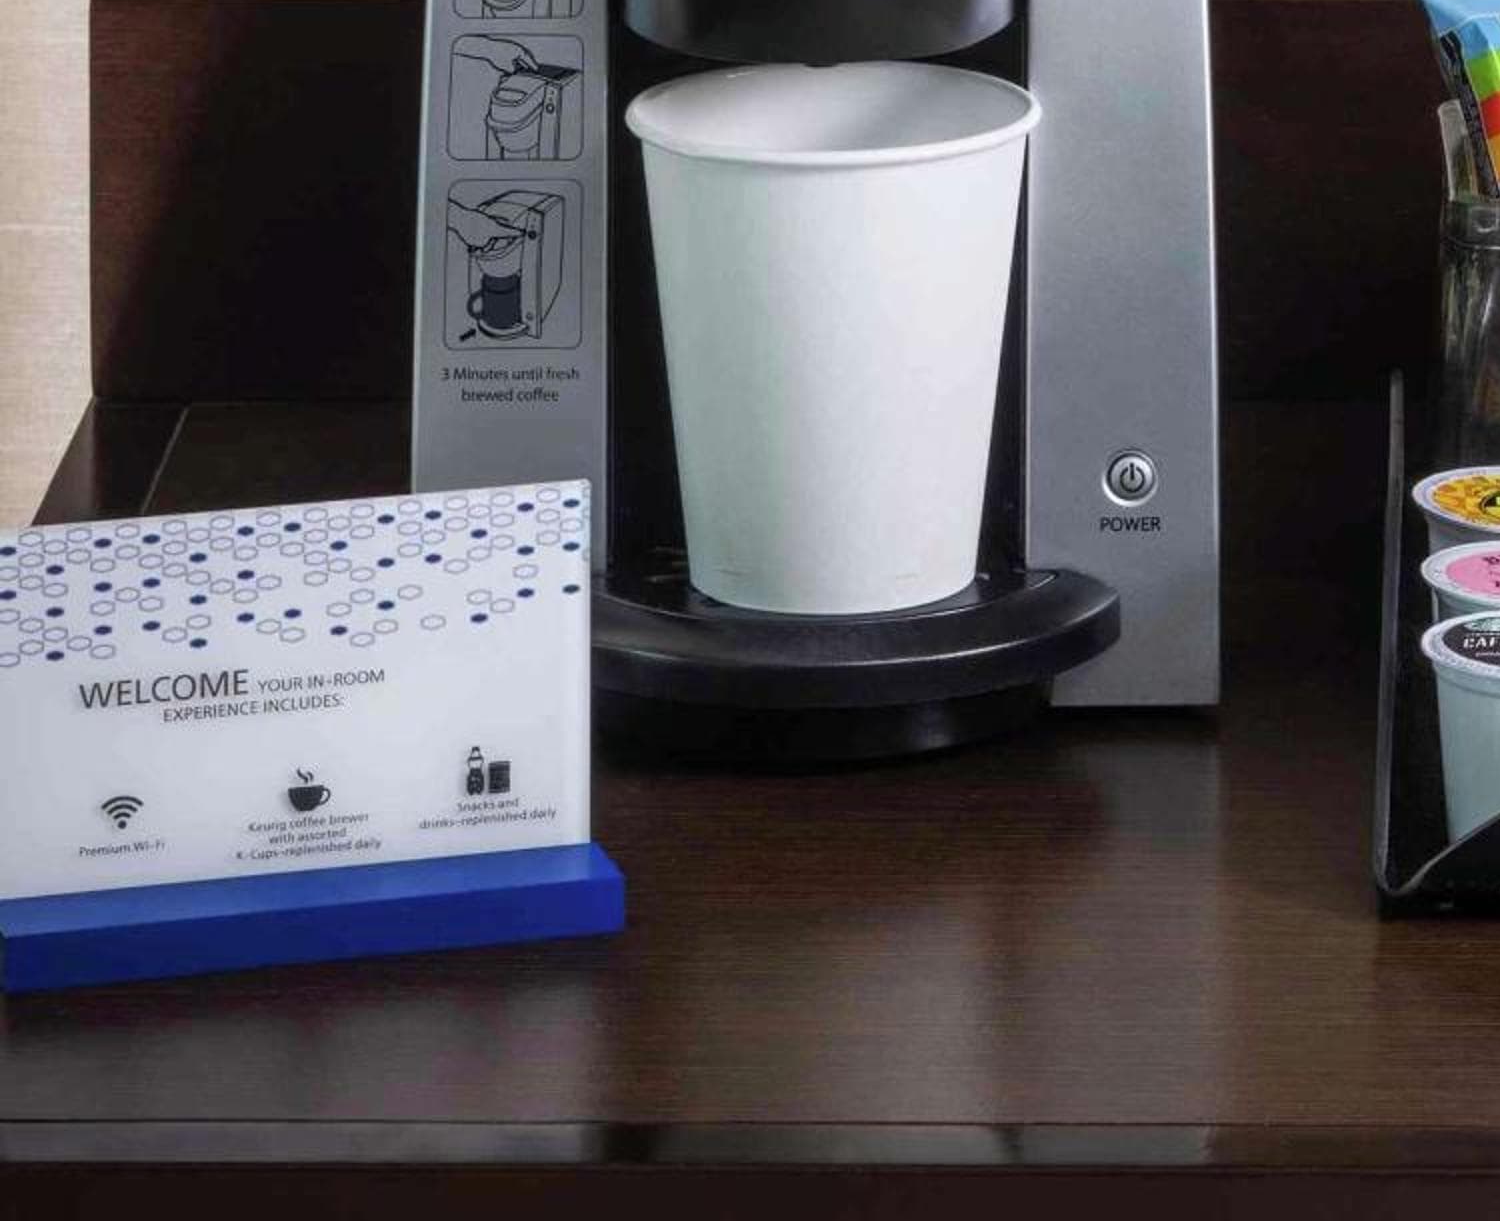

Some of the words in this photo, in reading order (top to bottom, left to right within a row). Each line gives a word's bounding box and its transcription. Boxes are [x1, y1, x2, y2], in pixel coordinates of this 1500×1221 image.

[441, 368, 450, 380] 3
[452, 367, 510, 380] Minutes
[511, 367, 544, 380] until
[545, 366, 580, 380] fresh
[461, 387, 513, 403] brewed
[515, 387, 560, 403] coffee
[1099, 516, 1161, 532] POWER
[79, 669, 250, 710] WELCOME
[257, 677, 303, 694] YOUR
[307, 668, 386, 689] IN-ROOM
[162, 699, 258, 723] EXPERIENCE
[263, 693, 345, 714] INCLUDES:
[456, 800, 495, 813] Snacks
[497, 798, 520, 810] and
[288, 815, 328, 830] coffee
[329, 812, 370, 826] brewer
[529, 807, 557, 821] daily
[268, 832, 295, 845] with
[296, 827, 348, 843] assorted
[79, 843, 131, 858] Premium
[133, 839, 166, 854] Wi-Fi
[354, 837, 383, 852] daily
